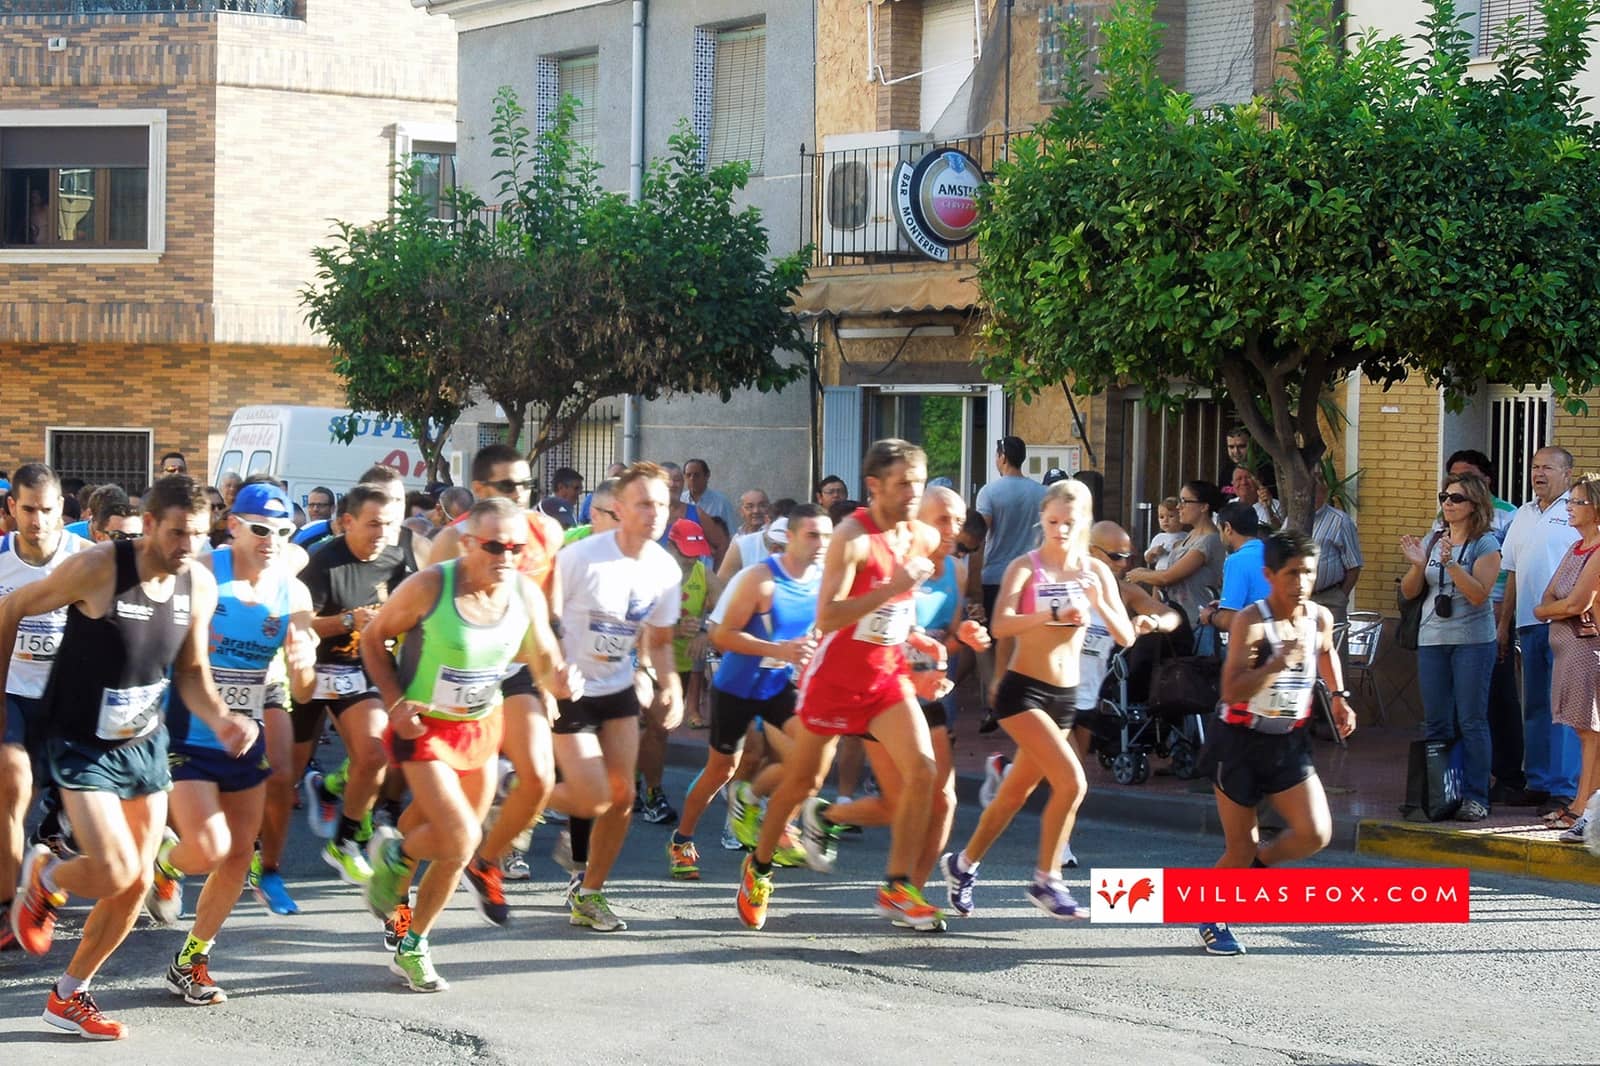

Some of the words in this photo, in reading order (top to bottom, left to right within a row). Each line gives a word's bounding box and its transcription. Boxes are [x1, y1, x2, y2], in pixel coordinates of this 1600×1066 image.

[900, 173, 910, 196] BAR
[902, 206, 945, 257] MONTERREY
[18, 635, 54, 651] 156
